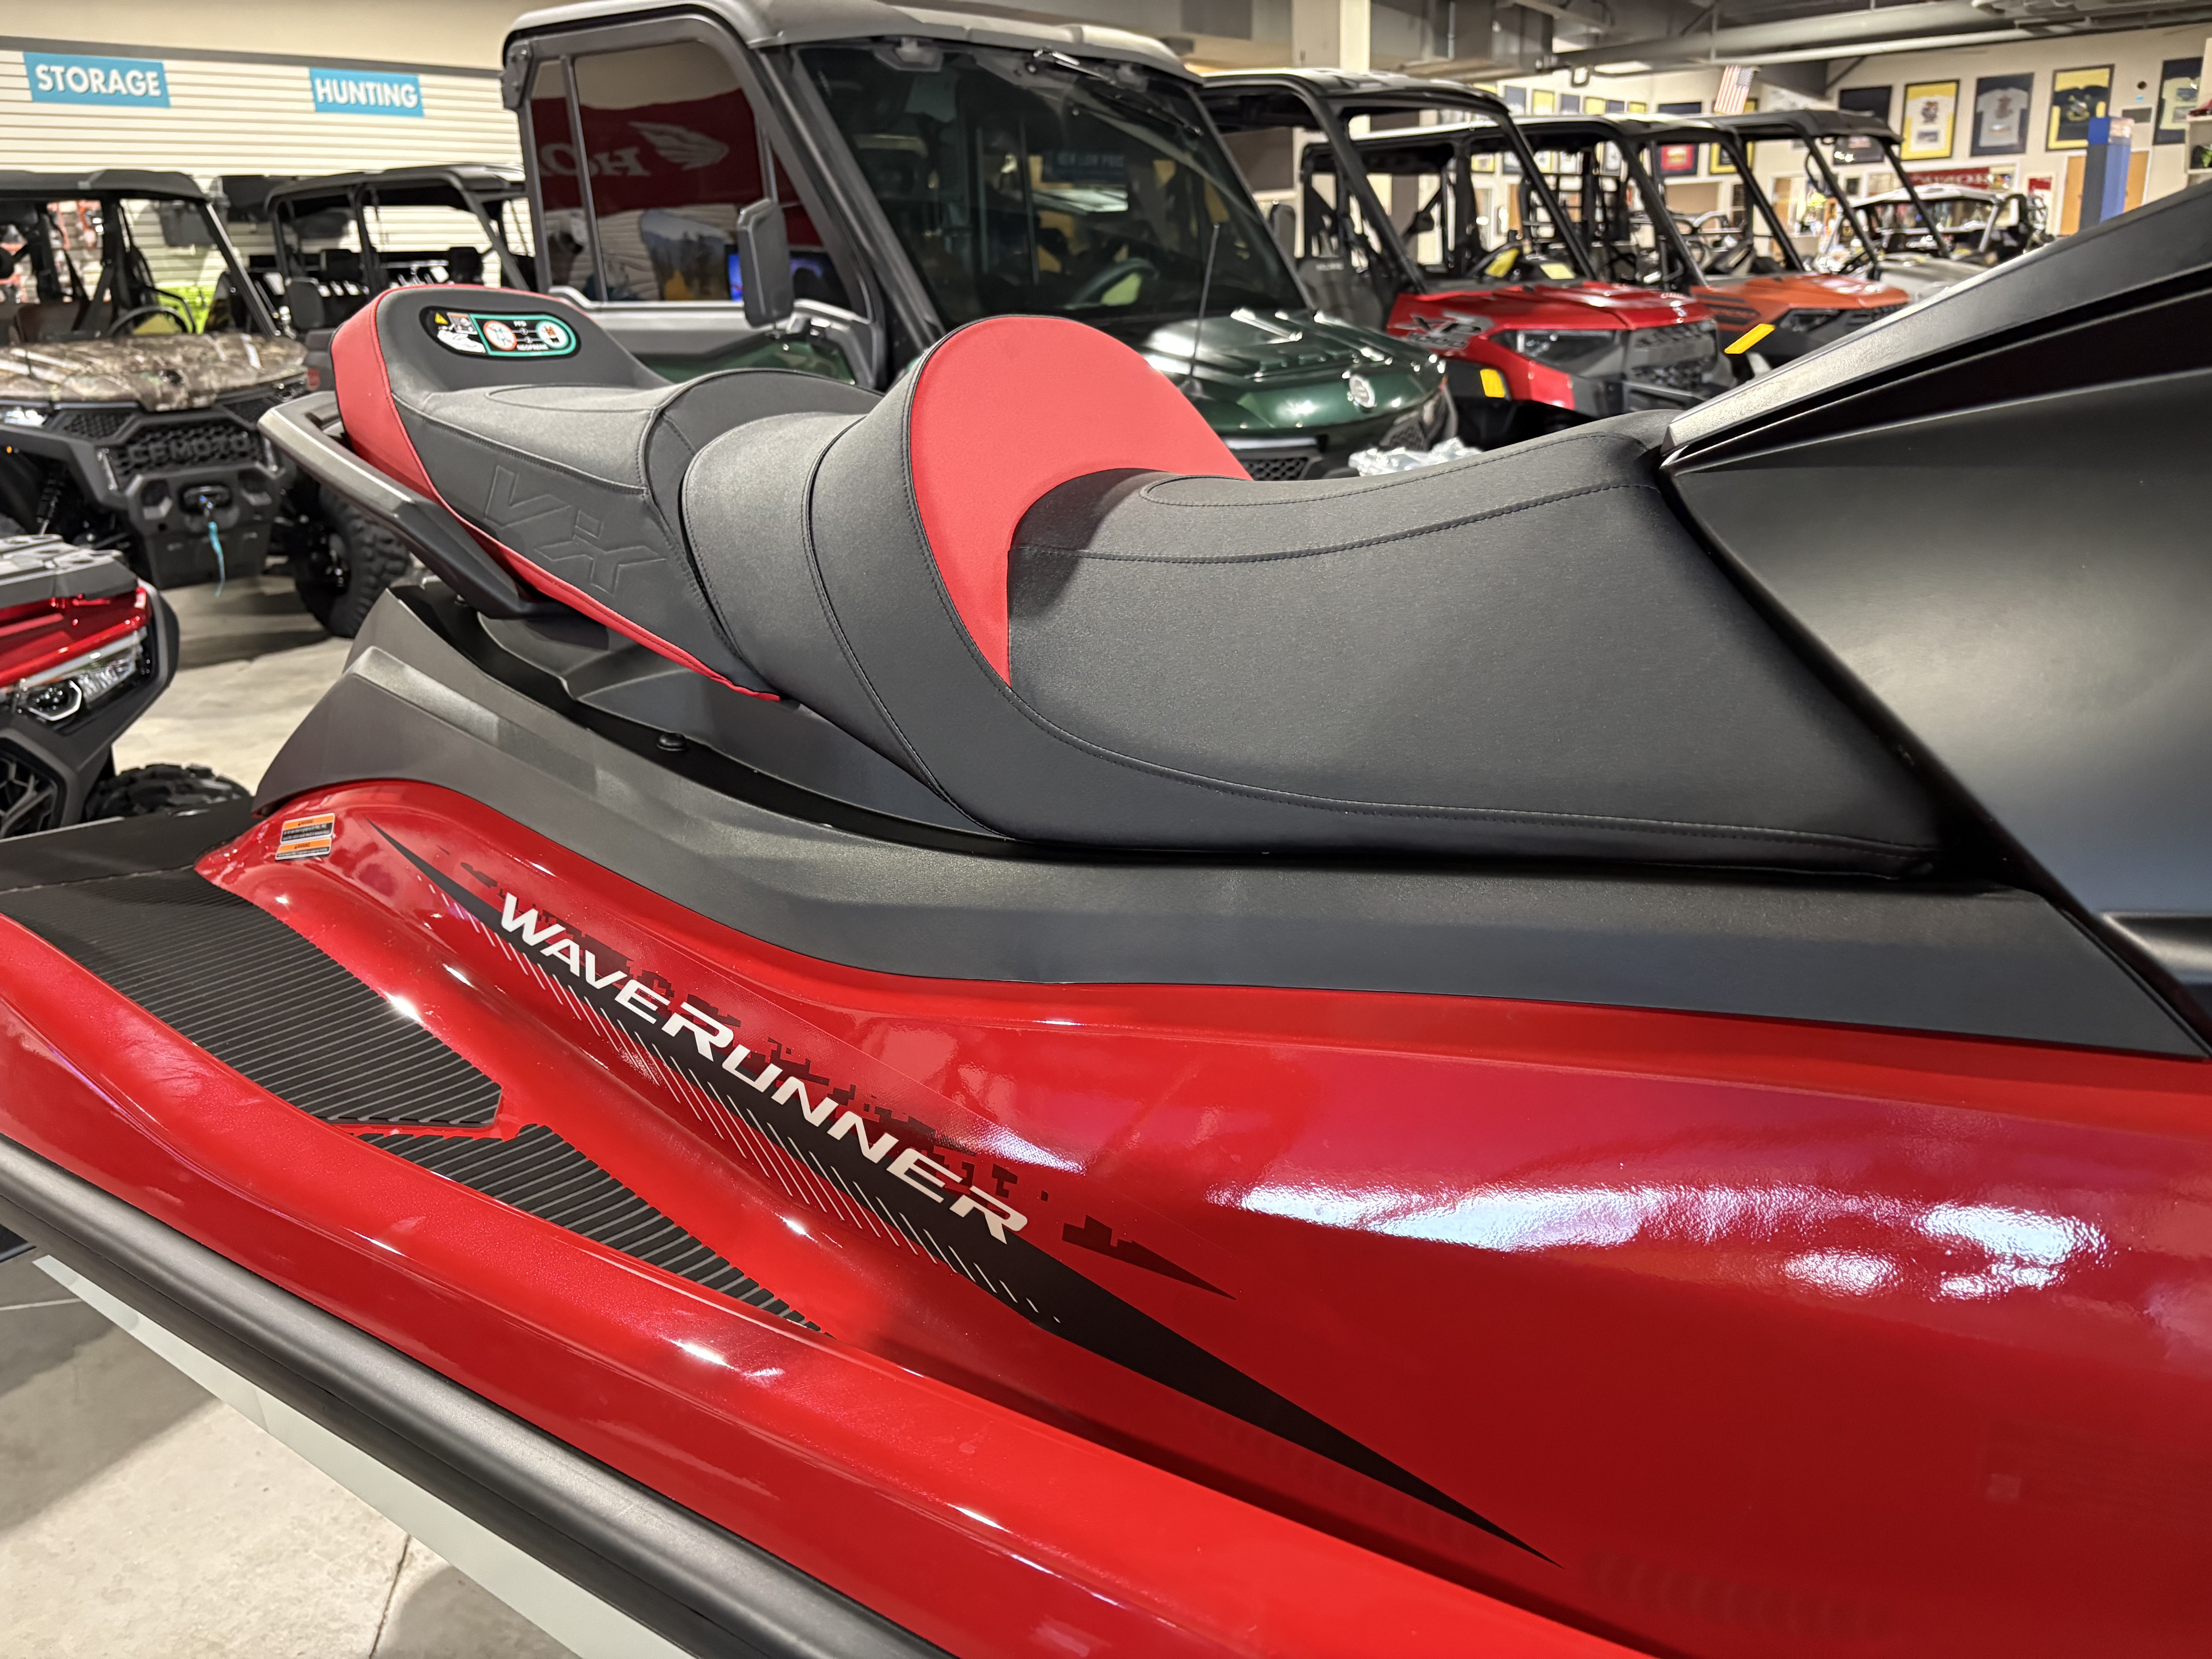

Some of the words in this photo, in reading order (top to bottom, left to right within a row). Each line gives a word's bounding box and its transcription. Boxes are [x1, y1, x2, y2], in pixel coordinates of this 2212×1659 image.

[36, 64, 161, 96] STORAGE
[314, 78, 418, 108] HUNTING
[127, 434, 251, 464] CFMOTO
[484, 465, 667, 596] VX
[501, 892, 1027, 1244] WAVERUNNER
